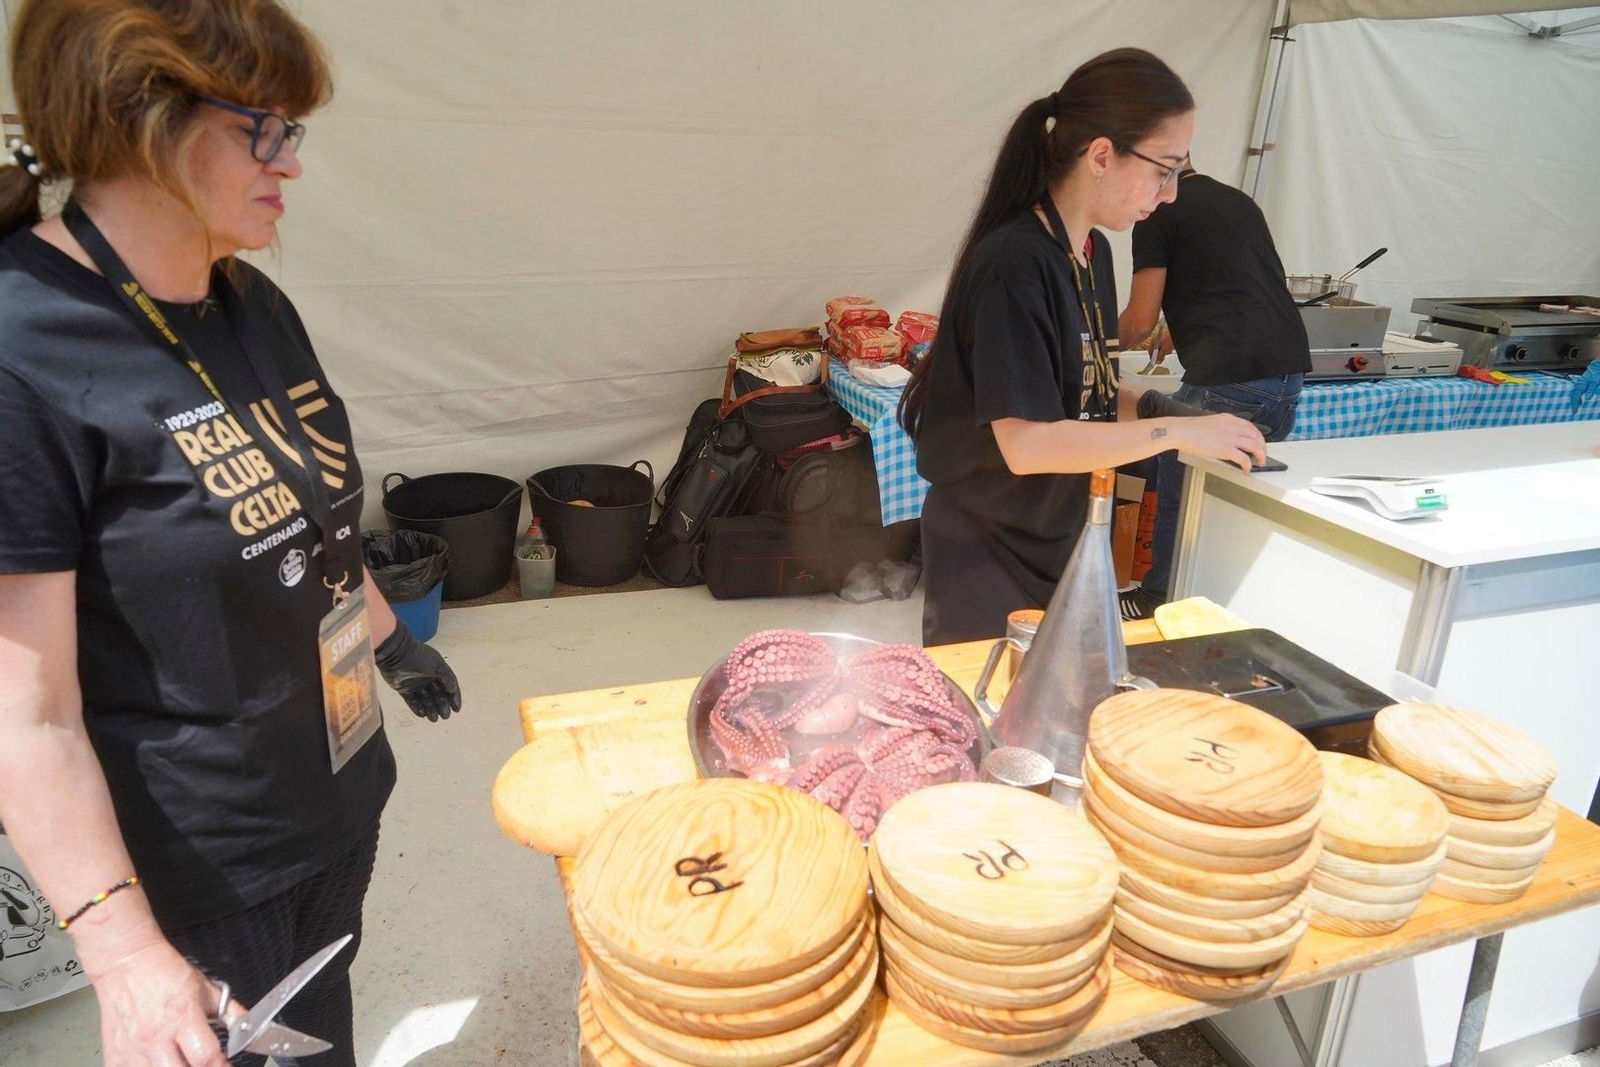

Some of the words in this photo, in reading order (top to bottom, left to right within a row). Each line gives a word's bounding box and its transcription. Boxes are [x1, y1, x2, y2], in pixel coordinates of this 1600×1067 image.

[164, 400, 225, 431] 1923-2023
[172, 413, 254, 466] REAL
[203, 448, 275, 498] CLUB
[230, 481, 301, 536] CELTA
[241, 517, 307, 560] CENTENARIO
[331, 622, 363, 661] STAFF
[1183, 737, 1240, 774] PR
[674, 852, 744, 897] PR
[962, 839, 1029, 880] PR
